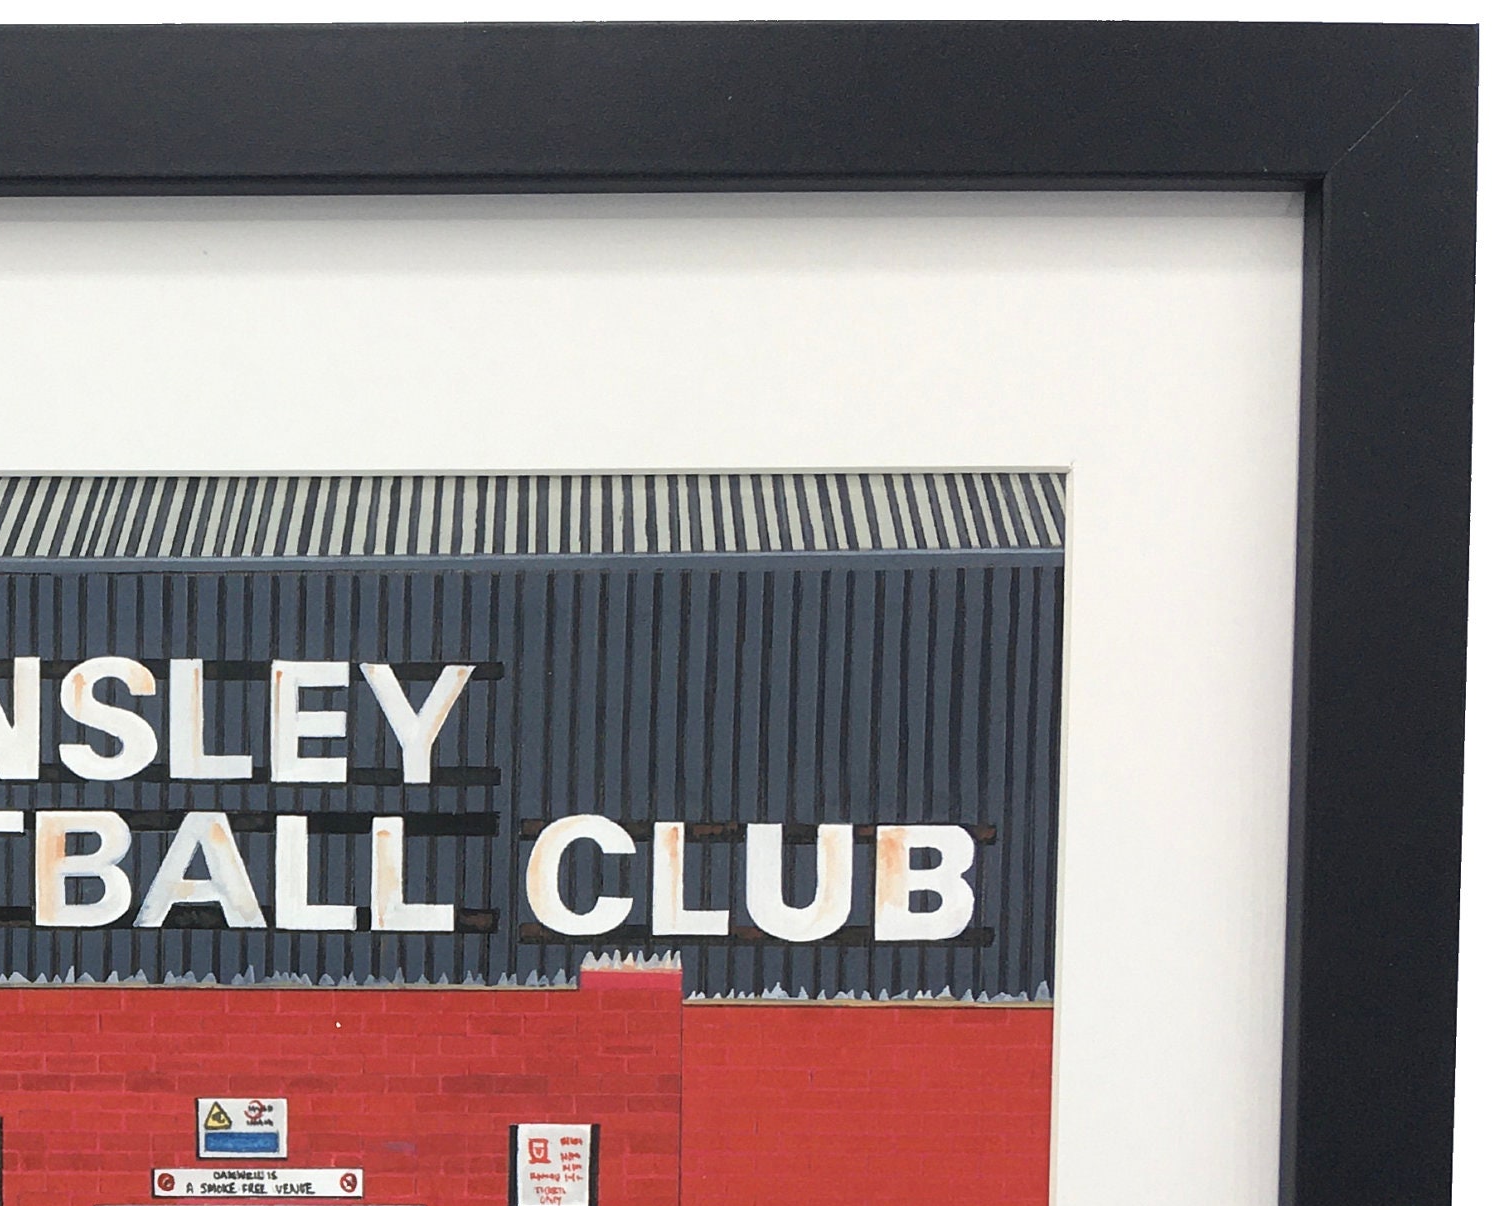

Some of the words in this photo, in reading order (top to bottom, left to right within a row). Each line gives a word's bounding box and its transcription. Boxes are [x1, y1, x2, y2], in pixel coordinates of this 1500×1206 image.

[525, 813, 976, 942] CLUB
[186, 1182, 194, 1194] A
[200, 1182, 237, 1194] SMOKE
[242, 1183, 268, 1194] FREE
[275, 1182, 316, 1195] VENUE
